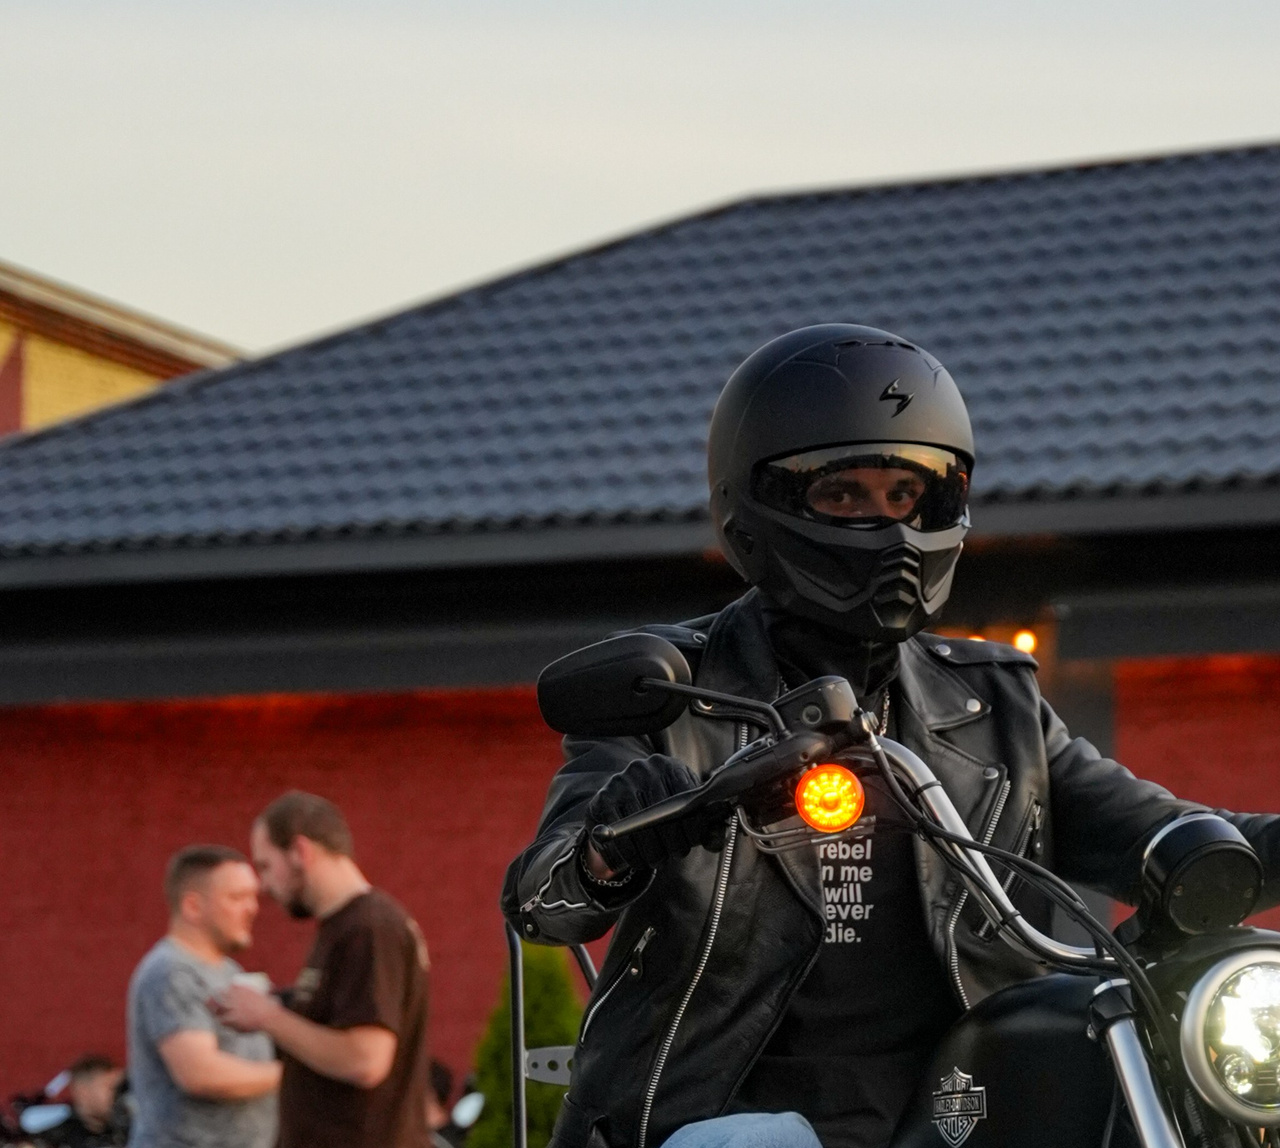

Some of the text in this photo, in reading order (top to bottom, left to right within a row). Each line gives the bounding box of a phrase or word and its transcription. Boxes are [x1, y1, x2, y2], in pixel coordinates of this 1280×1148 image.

[819, 839, 872, 860] rebel
[840, 865, 873, 882] me
[824, 883, 862, 903] will
[825, 904, 874, 920] ever
[824, 923, 862, 943] die.
